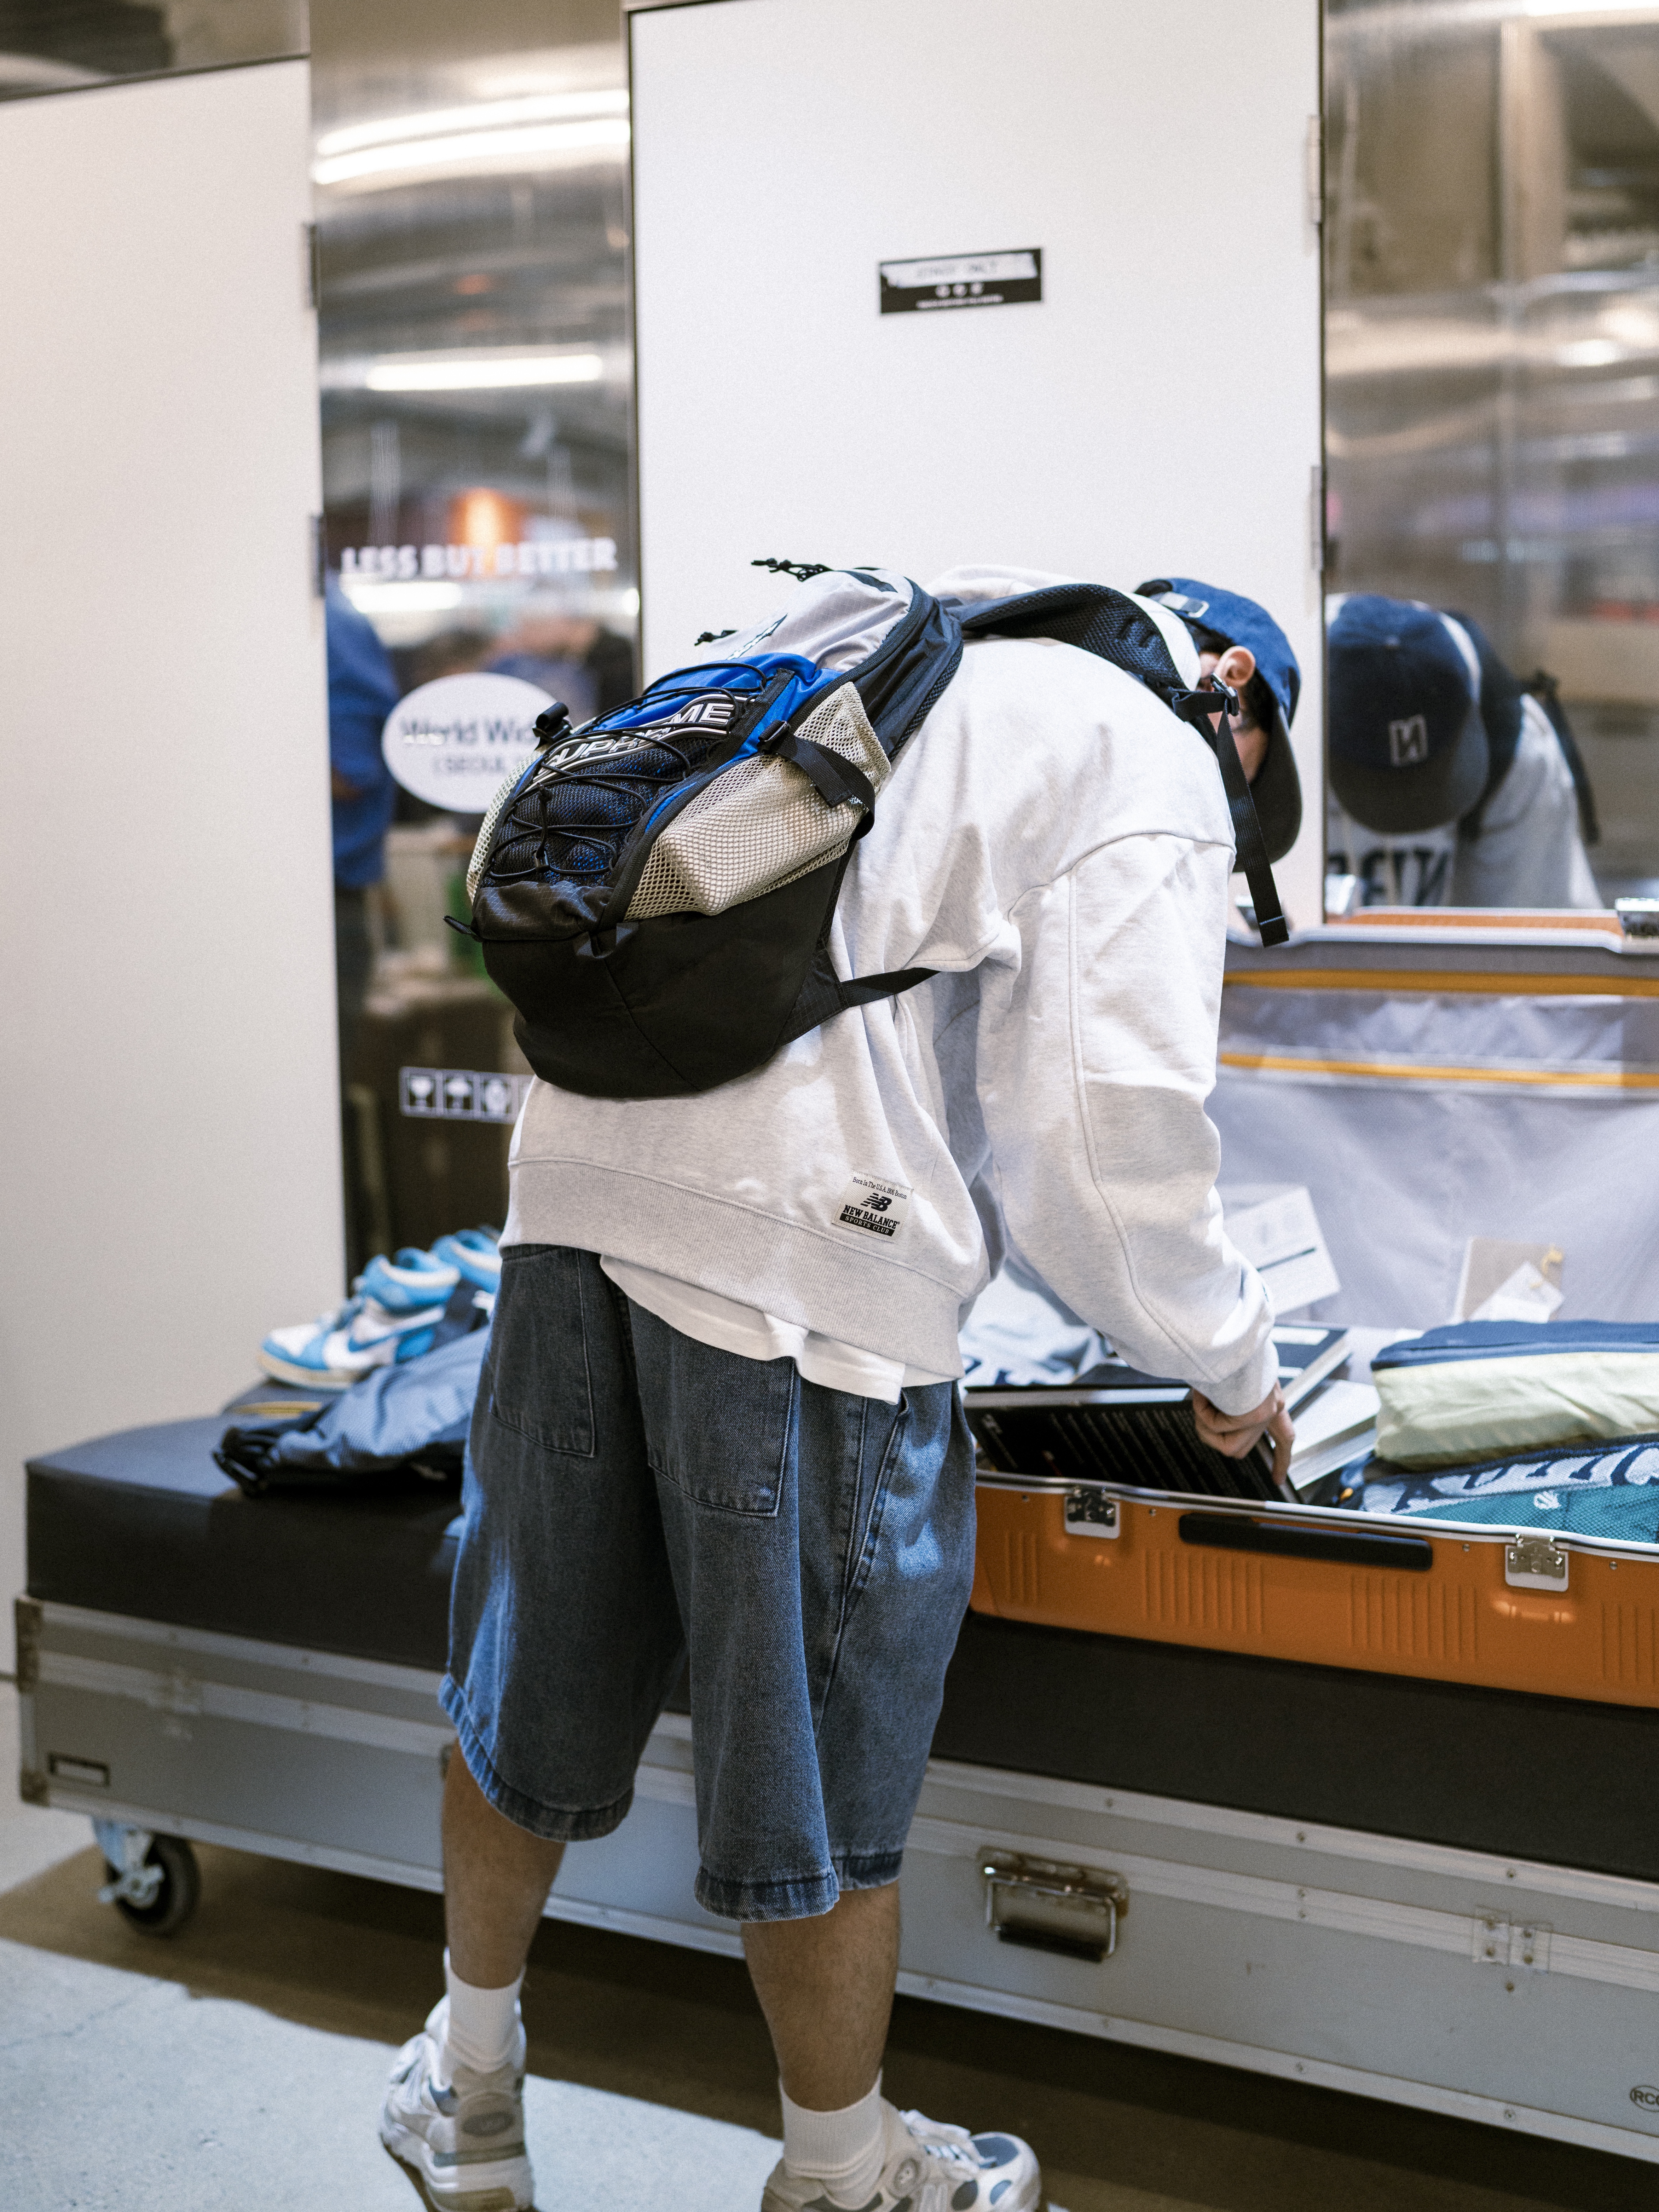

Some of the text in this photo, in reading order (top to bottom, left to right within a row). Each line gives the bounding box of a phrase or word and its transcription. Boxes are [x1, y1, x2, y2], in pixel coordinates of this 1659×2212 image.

[341, 537, 618, 580] LESS BUT BETTER
[852, 1177, 862, 1185] Born
[876, 1184, 886, 1193] U.S.A.
[895, 1190, 907, 1199] Boston
[843, 1204, 863, 1217] NEW
[845, 1216, 889, 1234] SPORTS CLUB
